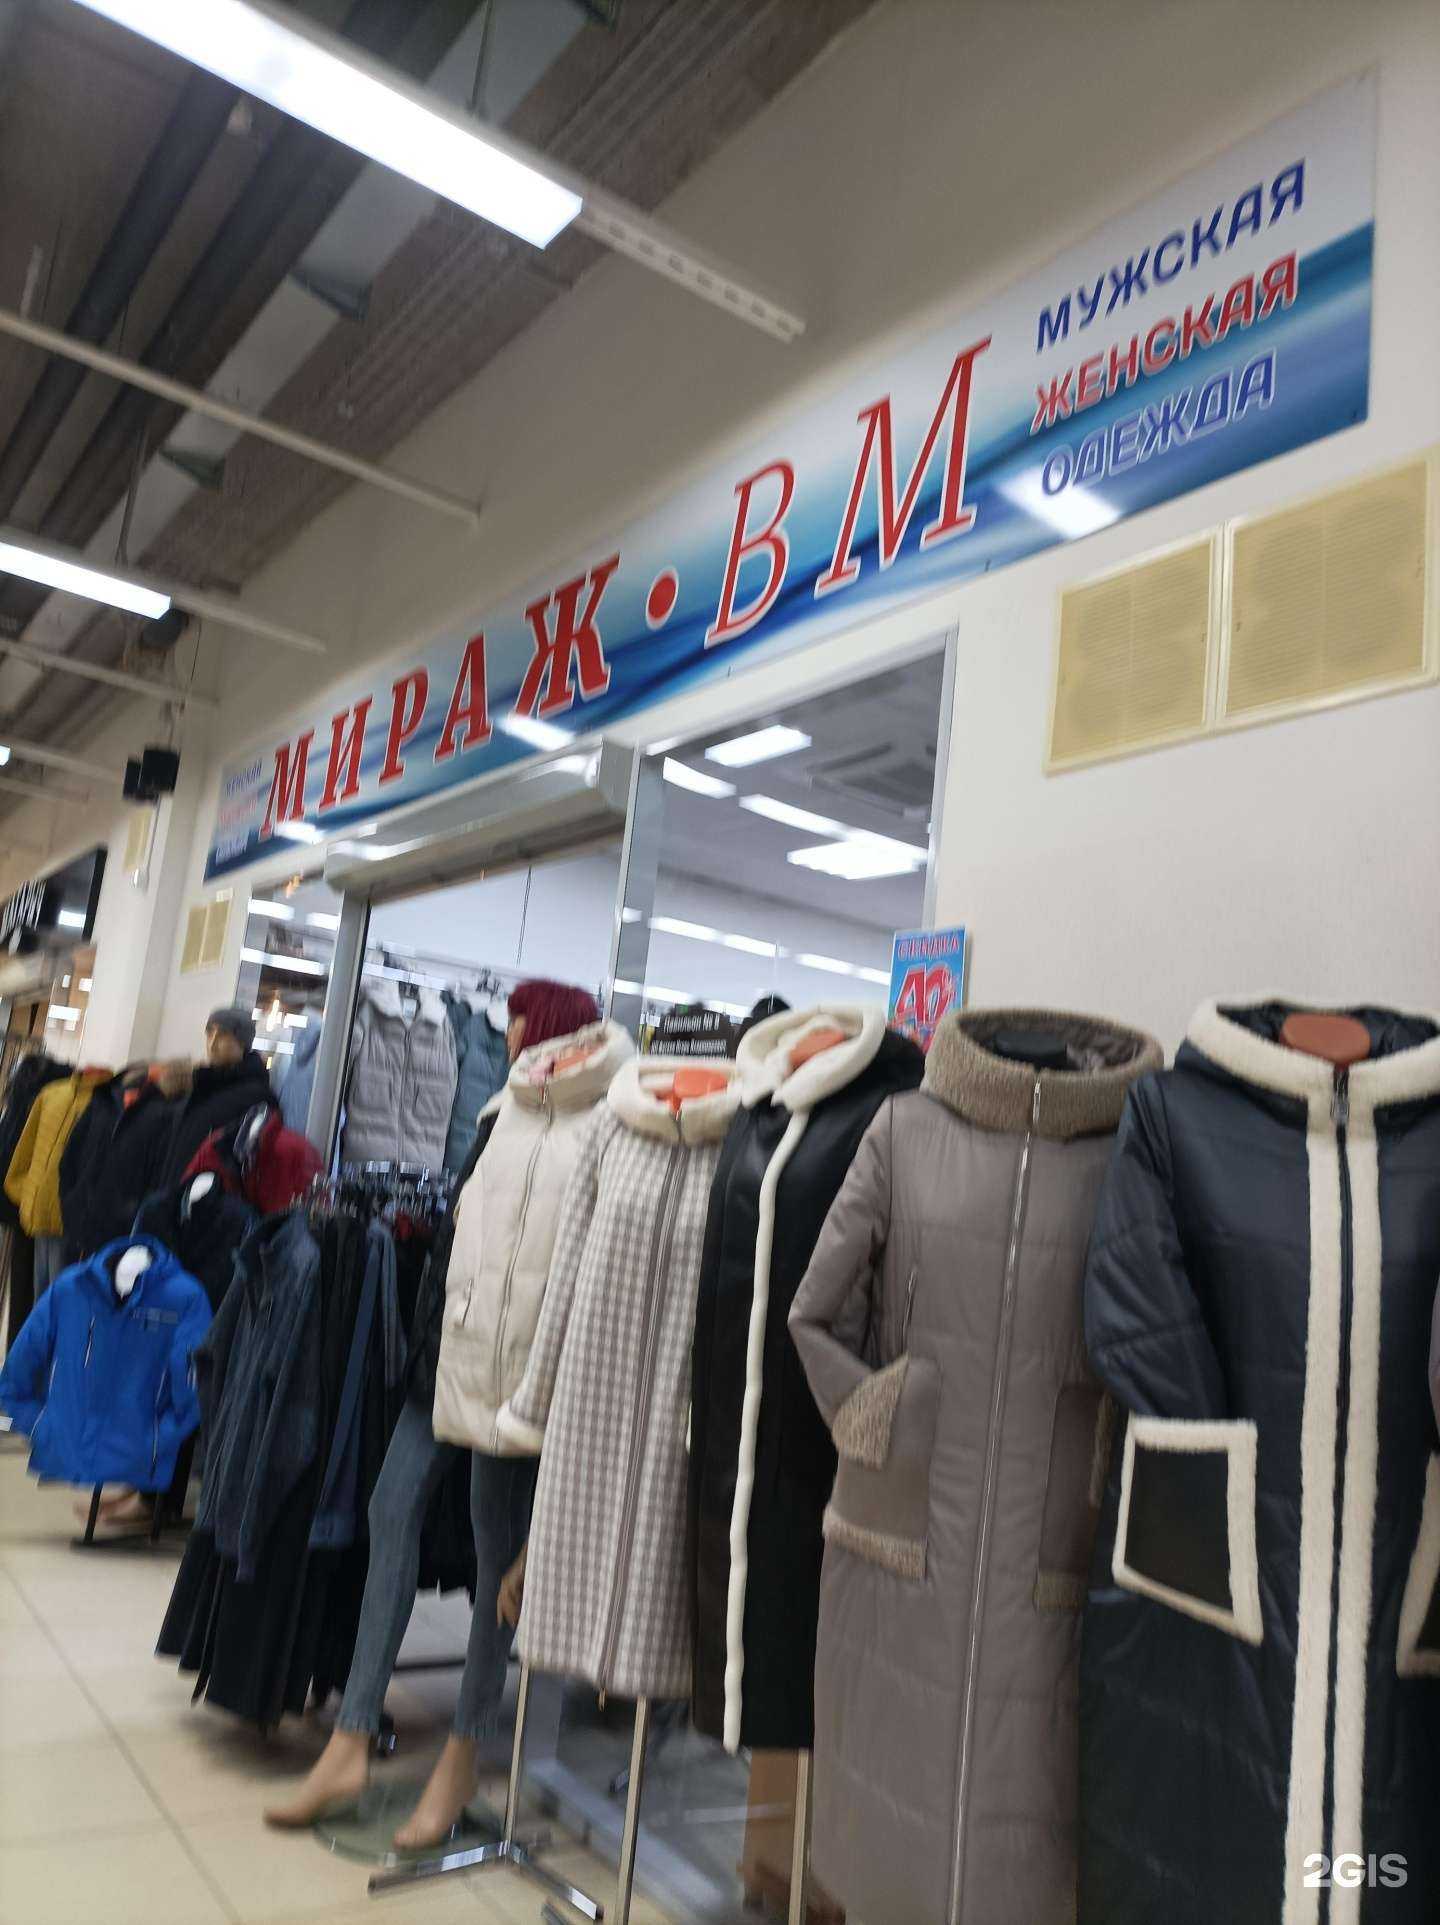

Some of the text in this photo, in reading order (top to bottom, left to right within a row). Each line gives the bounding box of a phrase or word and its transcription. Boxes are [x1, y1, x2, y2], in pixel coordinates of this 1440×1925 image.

[1030, 249, 1298, 435] ЖЕНСКАЯ
[1036, 158, 1305, 353] МУЖСКАЯ
[1041, 347, 1277, 496] ОДЕЖДА
[259, 334, 992, 840] МИРАЖ ВМ
